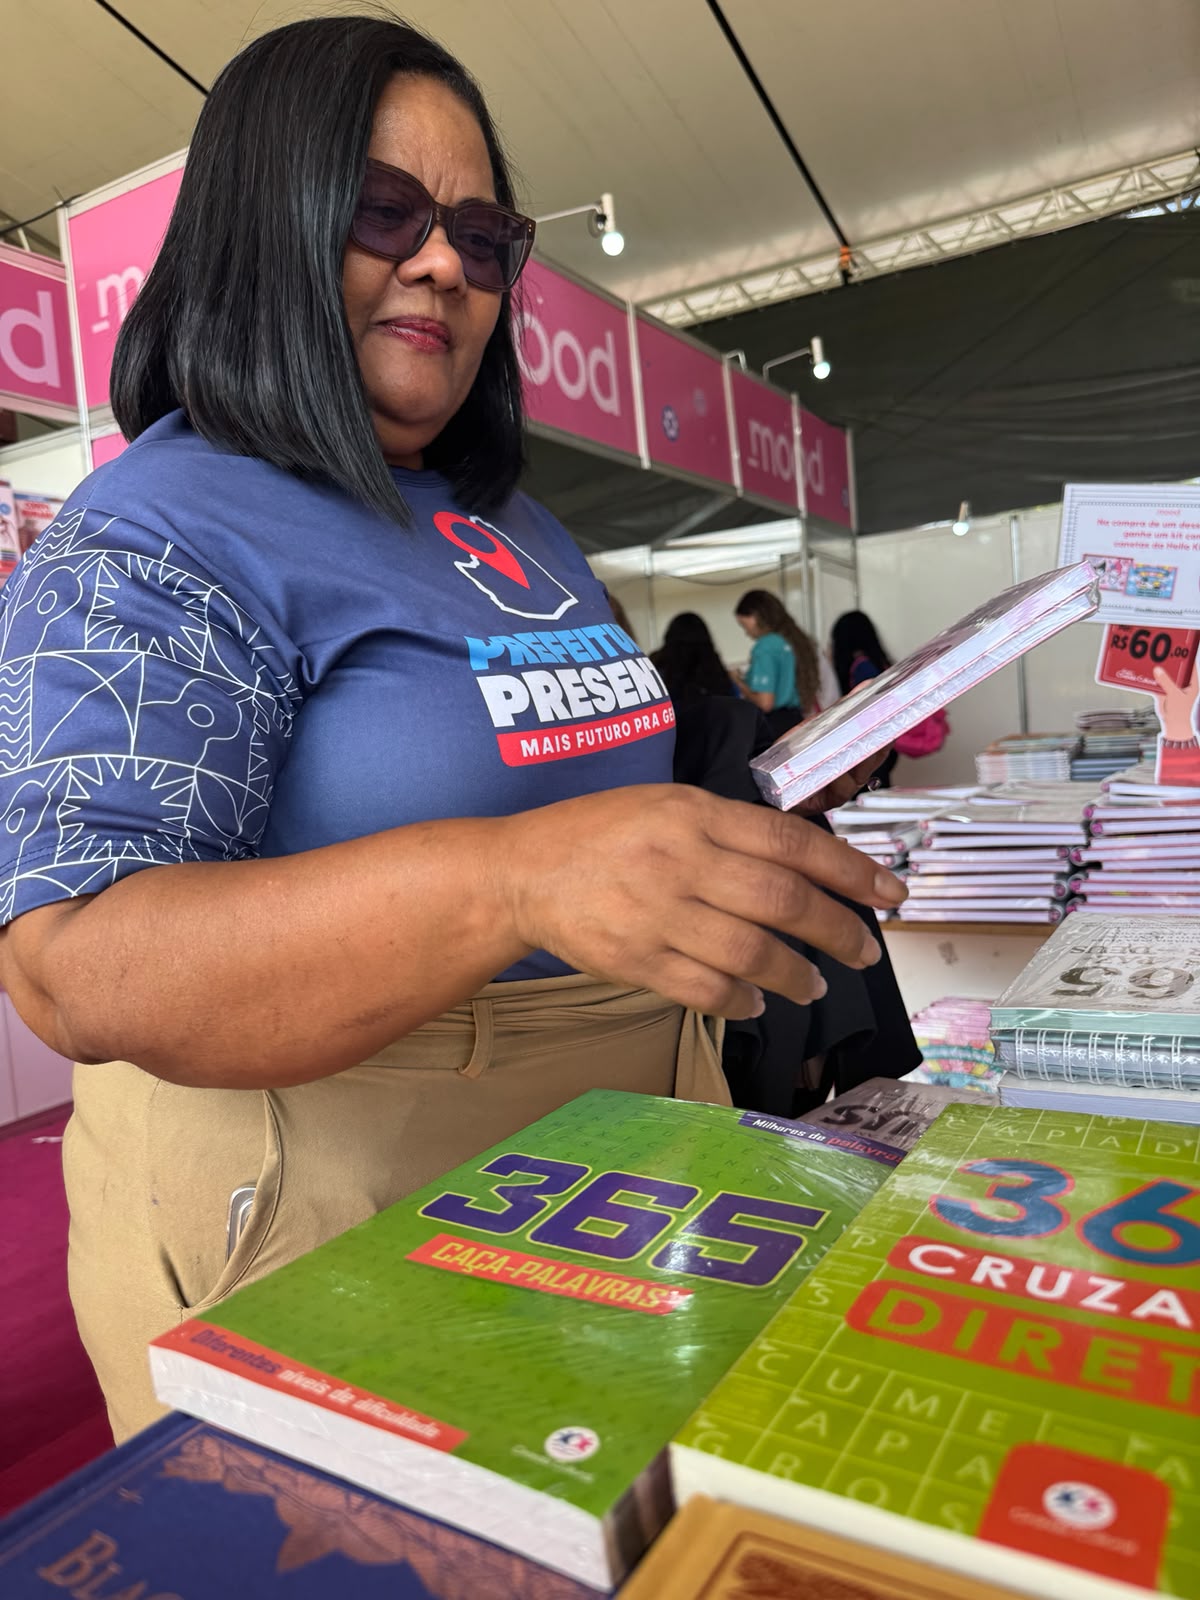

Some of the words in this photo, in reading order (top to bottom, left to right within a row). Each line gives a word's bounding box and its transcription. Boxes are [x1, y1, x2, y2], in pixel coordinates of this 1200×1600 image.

[1111, 520, 1146, 530] compra
[1148, 520, 1160, 528] de
[464, 624, 641, 671] PREFEITU
[520, 733, 571, 758] MAIS
[576, 720, 631, 748] FUTURO
[634, 712, 660, 733] PRA
[753, 1119, 806, 1137] Milhares
[807, 1132, 826, 1142] de
[417, 1152, 832, 1289] 365
[928, 1157, 1200, 1269] 36
[431, 1242, 669, 1308] CAÇA-PALAVRAS
[908, 1243, 1193, 1329] CRUZA
[191, 1329, 282, 1374] Diferentes
[327, 1386, 356, 1406] de
[866, 1288, 1200, 1403] DIRET
